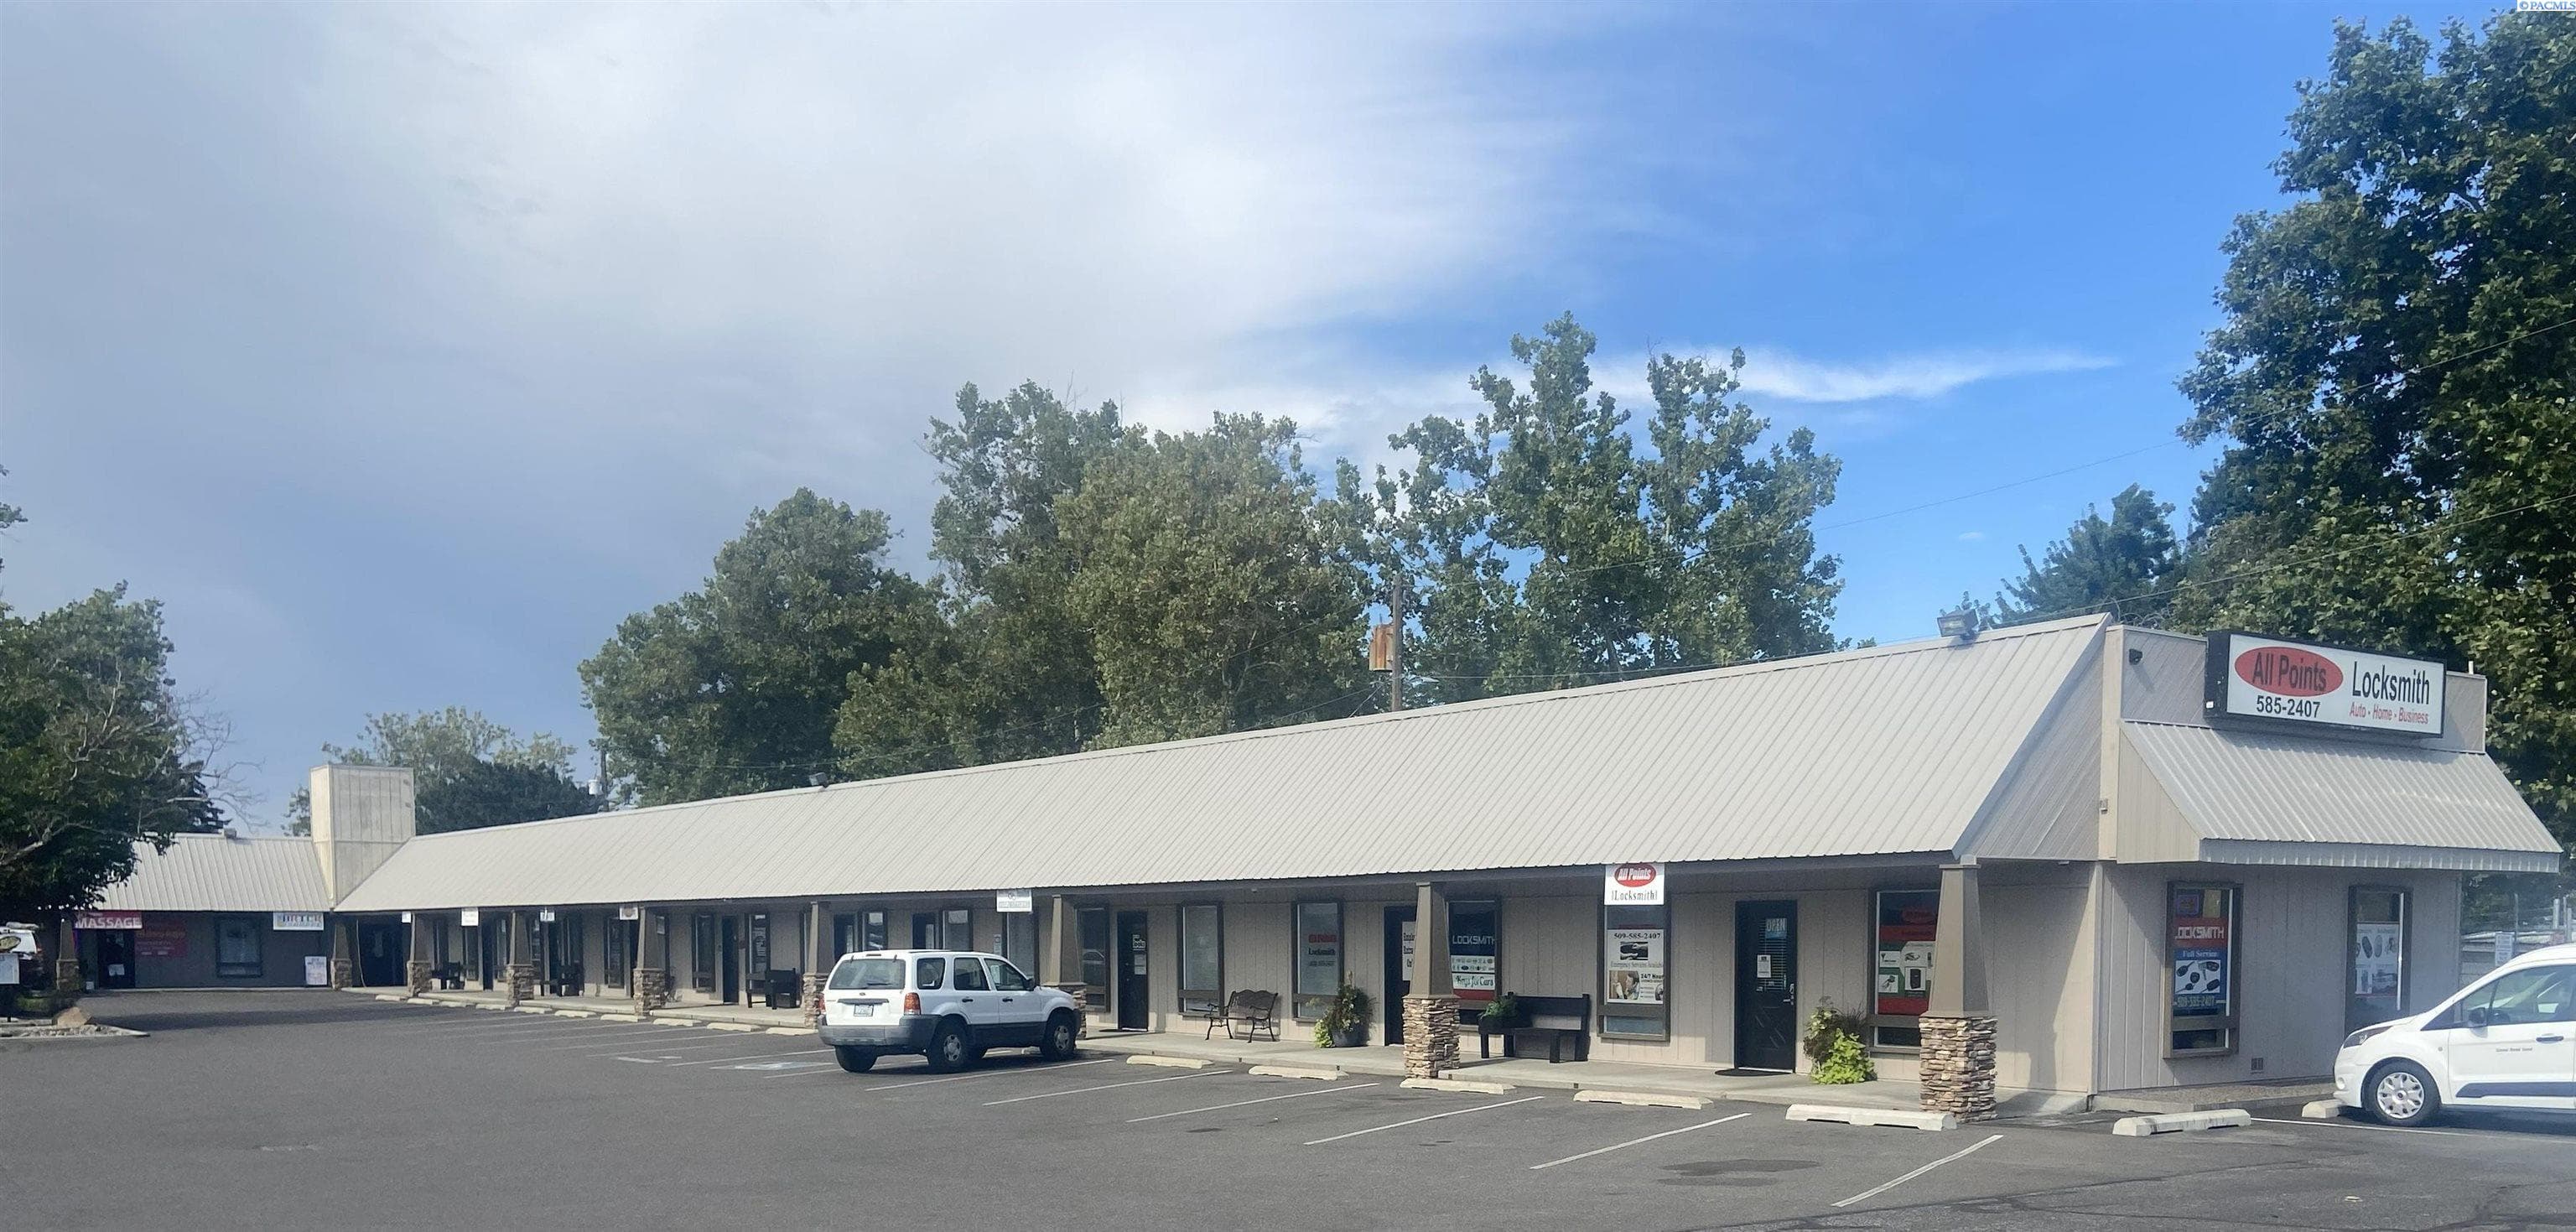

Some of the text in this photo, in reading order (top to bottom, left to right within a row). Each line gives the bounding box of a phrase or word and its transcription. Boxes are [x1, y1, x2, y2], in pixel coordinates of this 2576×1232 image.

[2252, 652, 2327, 692] All Points
[2352, 661, 2430, 704] Locksmith
[2257, 694, 2320, 718] 585-2407
[2350, 702, 2429, 725] Auto Home Business
[1618, 867, 1651, 881] All Points
[75, 918, 143, 928] MASSAGE
[1767, 918, 1785, 932] OPEN
